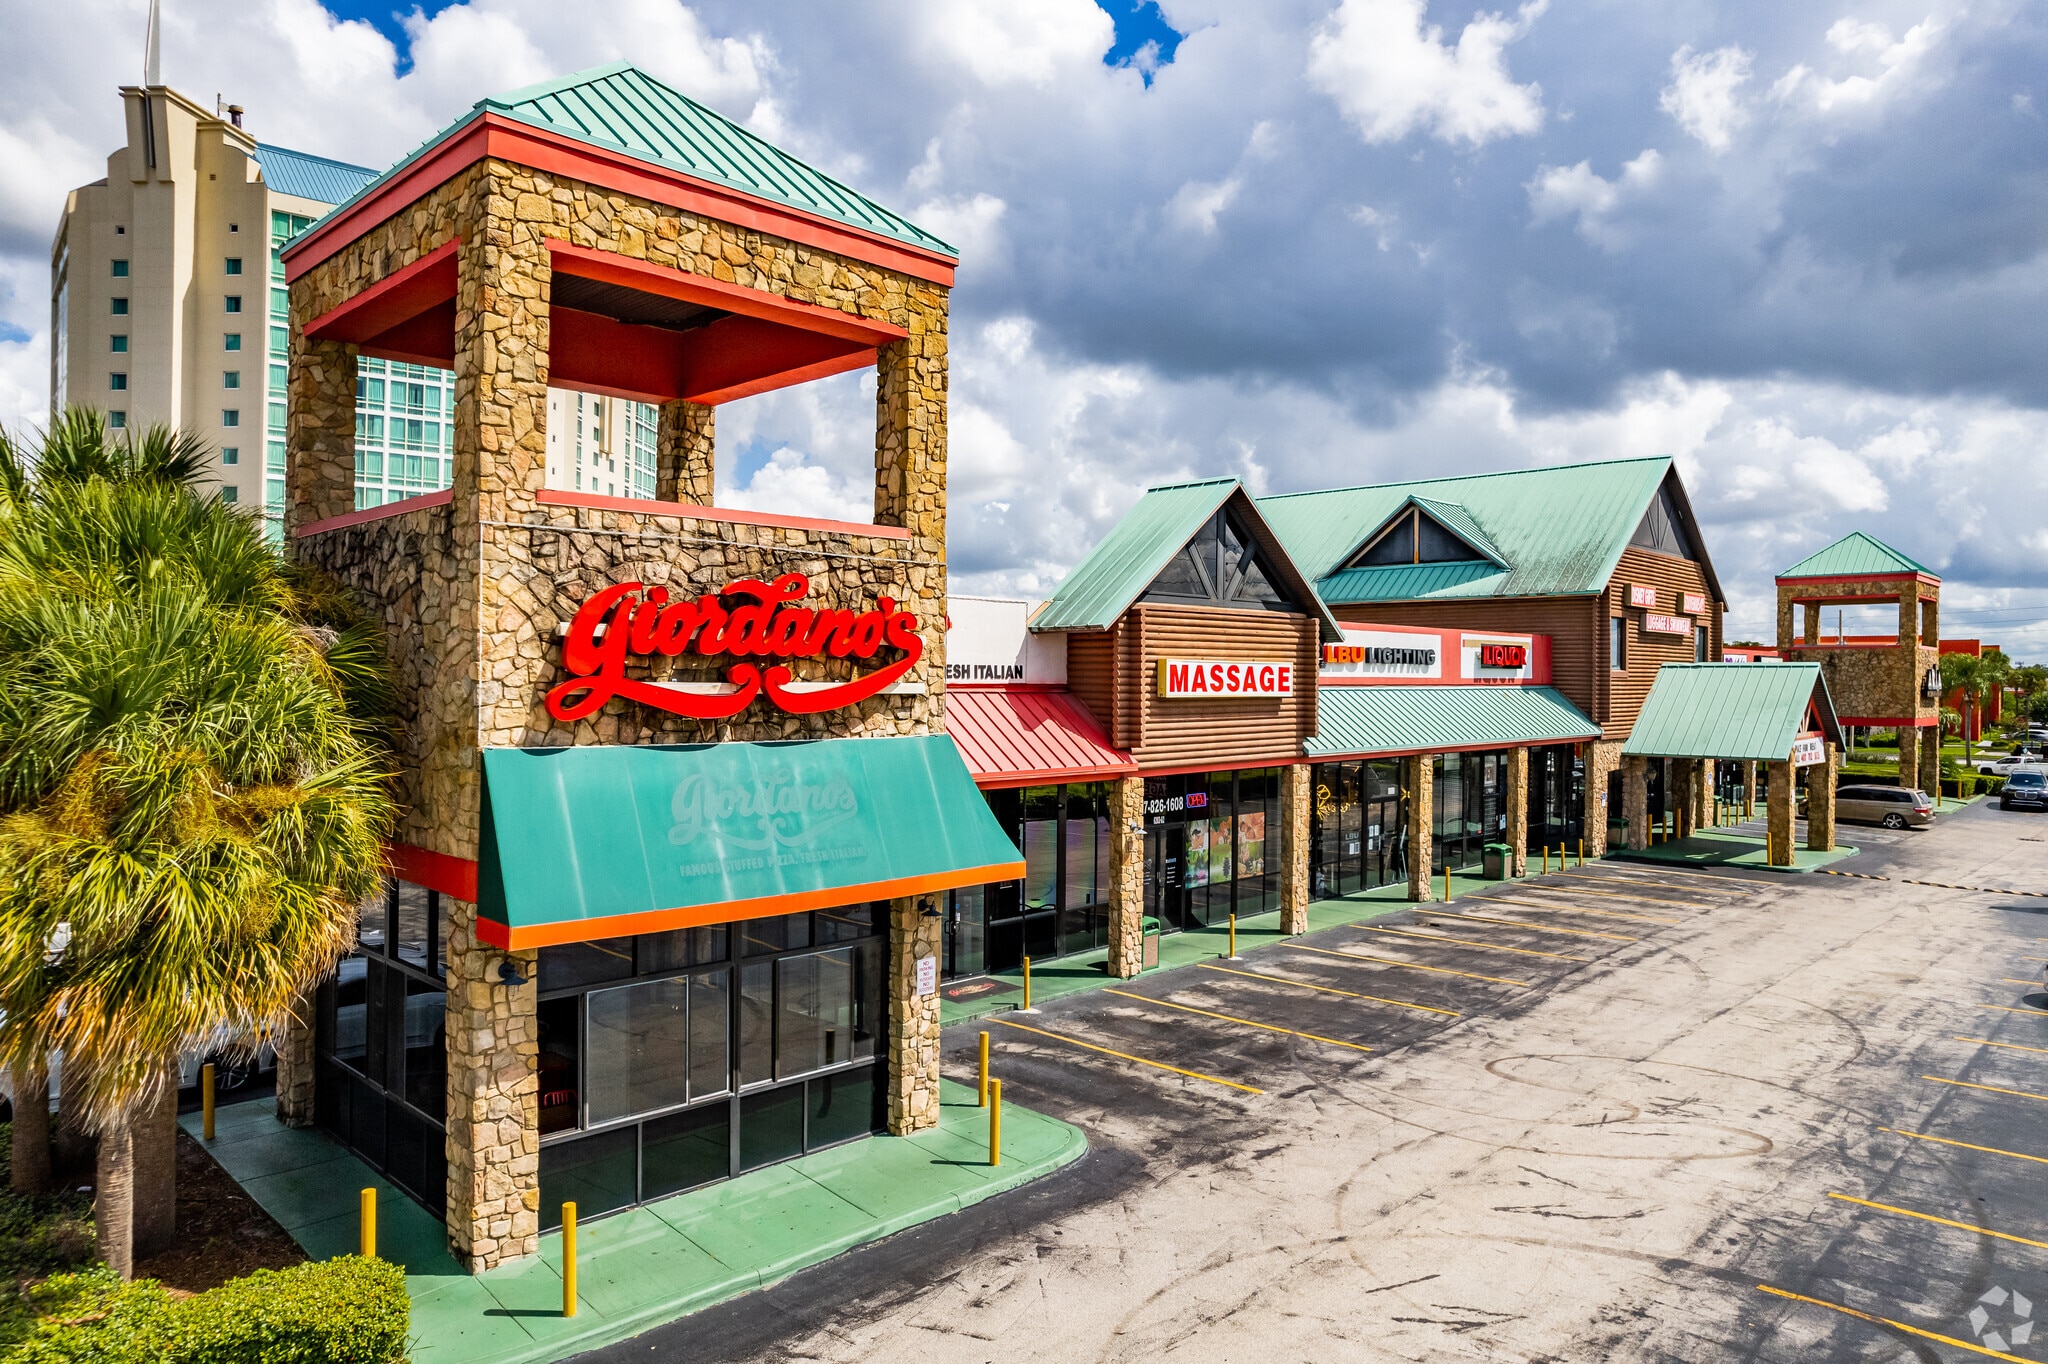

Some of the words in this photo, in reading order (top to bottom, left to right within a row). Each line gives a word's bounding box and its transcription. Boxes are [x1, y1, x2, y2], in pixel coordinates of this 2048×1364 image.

[546, 572, 924, 721] Giordano's
[1324, 645, 1365, 663] LBU
[1365, 647, 1435, 666] LIGHTING
[1484, 645, 1527, 667] LIQUOR
[946, 664, 970, 679] ESH
[974, 664, 1023, 679] ITALIAN
[1169, 664, 1290, 692] MASSAGE
[1144, 796, 1184, 814] 7-826-1608
[1188, 794, 1205, 807] OPEN
[680, 861, 721, 877] FAMOUS
[723, 857, 764, 873] STUFFED
[801, 850, 829, 864] FRESH
